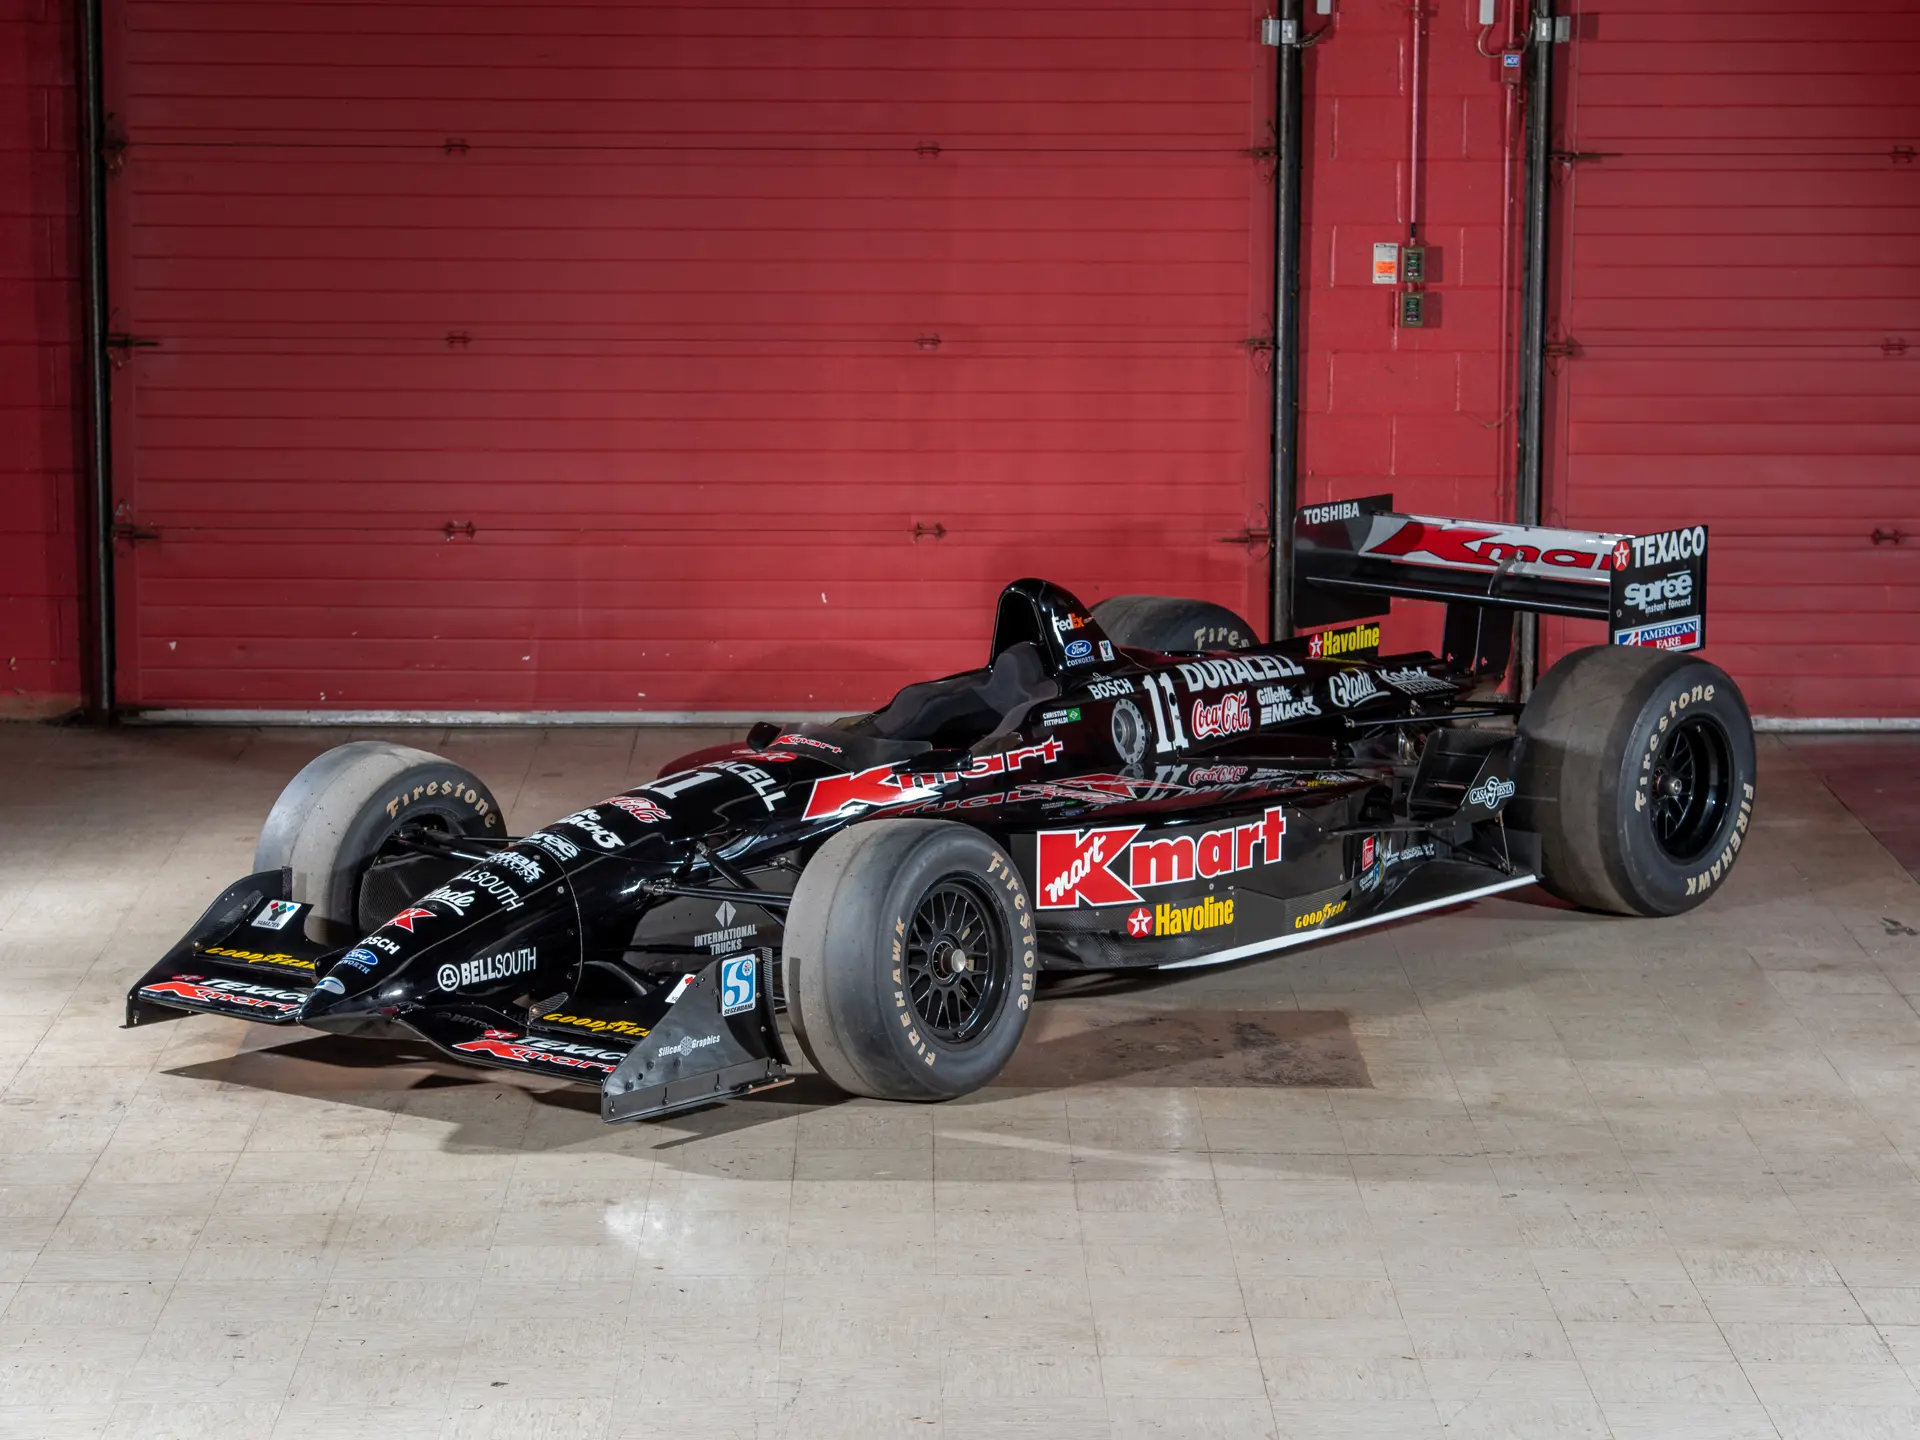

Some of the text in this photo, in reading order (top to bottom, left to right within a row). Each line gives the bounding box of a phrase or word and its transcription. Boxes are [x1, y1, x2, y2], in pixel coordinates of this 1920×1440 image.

[1304, 502, 1360, 525] TOSHIBA
[1362, 517, 1610, 574] Kma
[1632, 526, 1705, 568] TEXACO
[1053, 613, 1085, 631] FedEx
[1642, 621, 1697, 641] AMERICAN
[1322, 624, 1380, 657] Havoline
[1656, 636, 1682, 649] FARE
[1067, 655, 1095, 667] COSWORTH
[1176, 654, 1305, 692] DURACELL
[1087, 678, 1134, 699] BOSCH
[1256, 685, 1293, 707] Gillette
[1042, 709, 1068, 720] CHRISTIAN
[1043, 716, 1068, 727] FITTIPALDI
[1635, 684, 1715, 812] Firestone
[386, 780, 496, 828] Firestone
[1685, 783, 1754, 896] FIREHAWK
[1036, 805, 1287, 910] Kmart
[1044, 834, 1107, 903] mart
[1154, 896, 1235, 937] Havoline
[694, 923, 768, 947] INTERNATIONAL
[986, 850, 1035, 1011] Firestone
[710, 938, 742, 956] TRUCKS
[460, 946, 536, 986] BELLSOUTH
[199, 978, 308, 1003] TEXAC
[891, 914, 936, 1067] FIREHAWK
[514, 1035, 628, 1061] TEXAC
[658, 1034, 721, 1058] Silicon Graphics
